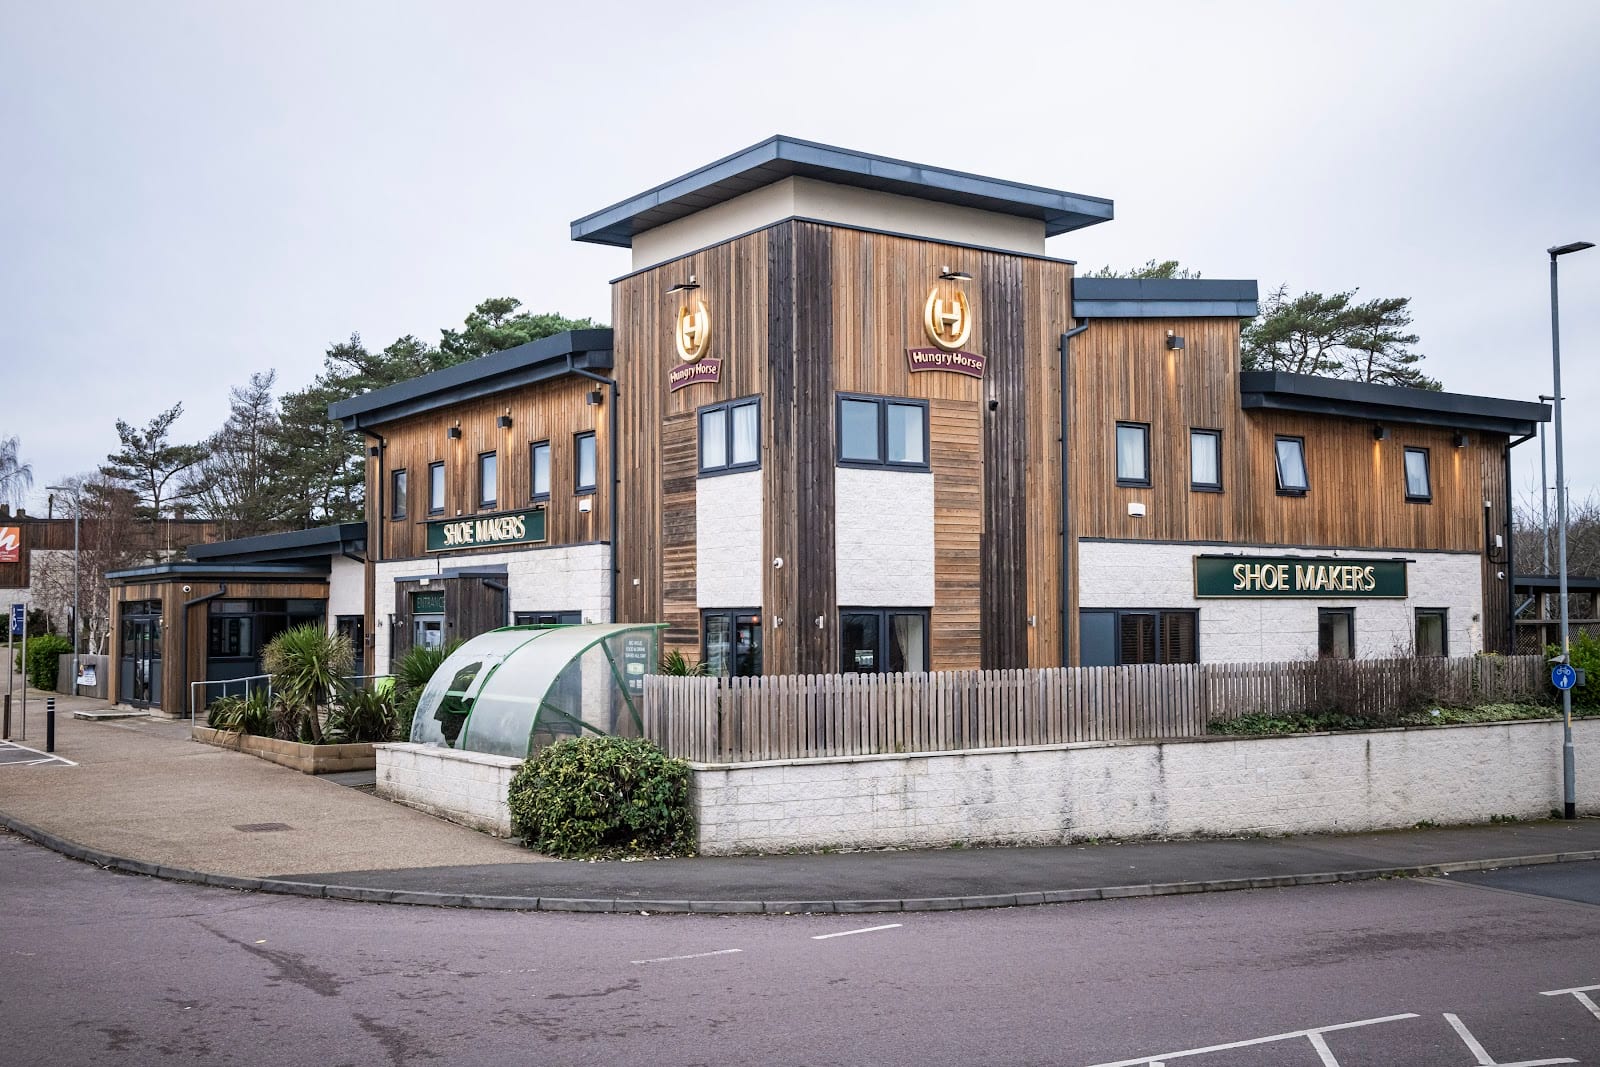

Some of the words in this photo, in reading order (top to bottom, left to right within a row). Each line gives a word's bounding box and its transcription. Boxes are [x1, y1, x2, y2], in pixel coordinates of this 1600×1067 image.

[443, 522, 474, 546] SHOE
[476, 515, 526, 542] MAKERS
[1233, 563, 1290, 591] SHOE
[1295, 565, 1376, 592] MAKERS
[417, 596, 445, 609] ENTRANC
